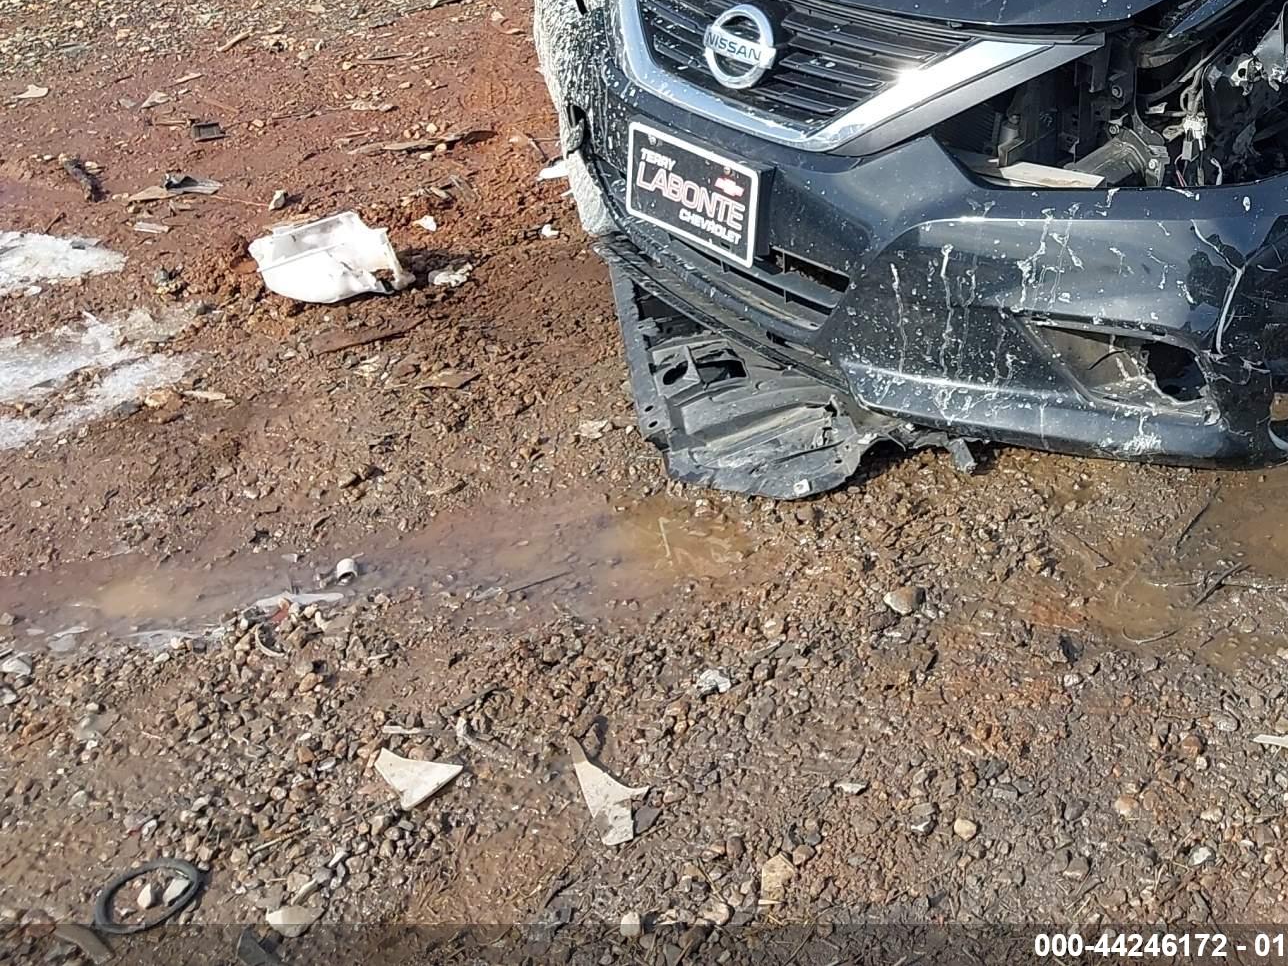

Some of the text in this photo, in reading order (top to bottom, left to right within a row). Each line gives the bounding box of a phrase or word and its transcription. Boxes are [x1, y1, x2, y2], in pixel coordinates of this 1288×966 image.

[705, 32, 762, 61] NISSAN
[639, 147, 676, 171] TERRY
[636, 161, 746, 231] LABONTE
[678, 208, 742, 245] CHEVROLET
